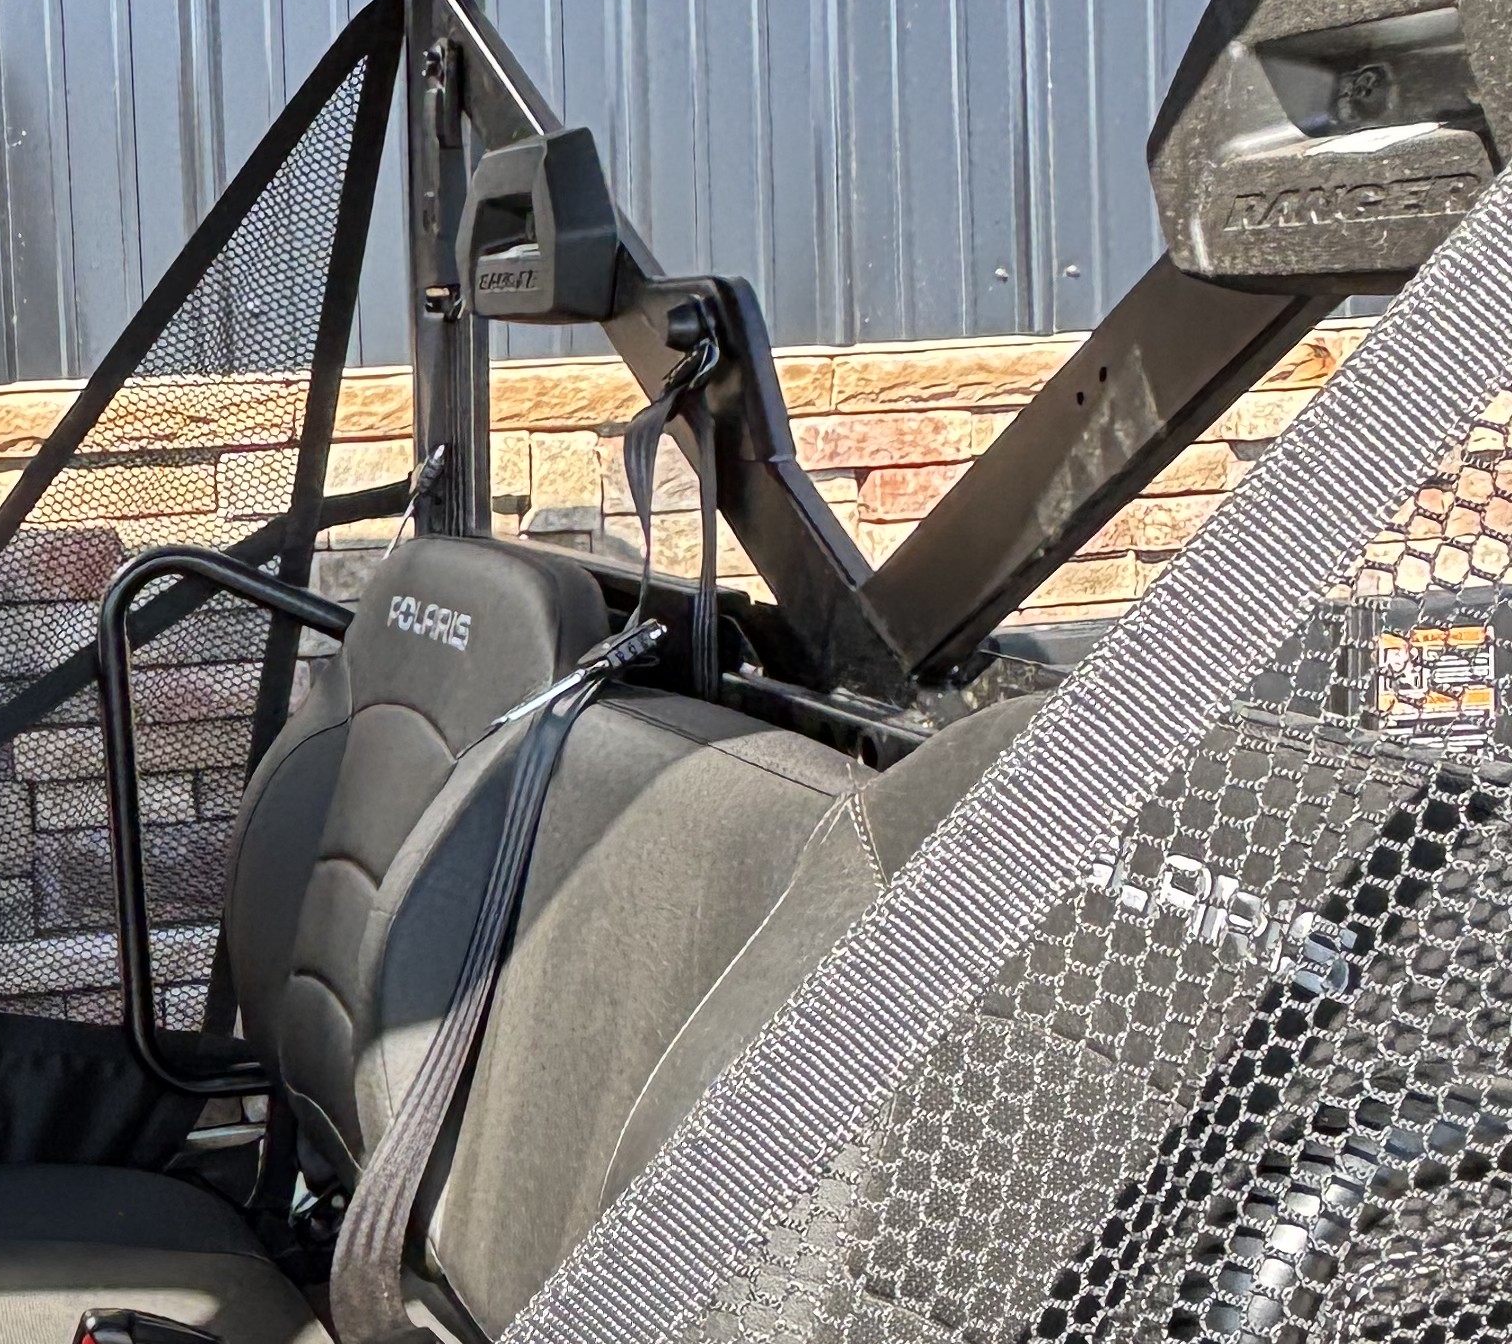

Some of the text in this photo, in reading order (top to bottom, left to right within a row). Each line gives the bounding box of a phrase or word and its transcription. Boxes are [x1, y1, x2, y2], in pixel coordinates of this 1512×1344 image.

[1223, 171, 1481, 231] RANGER
[386, 595, 472, 651] POLARIS
[1086, 839, 1361, 997] LARIS
